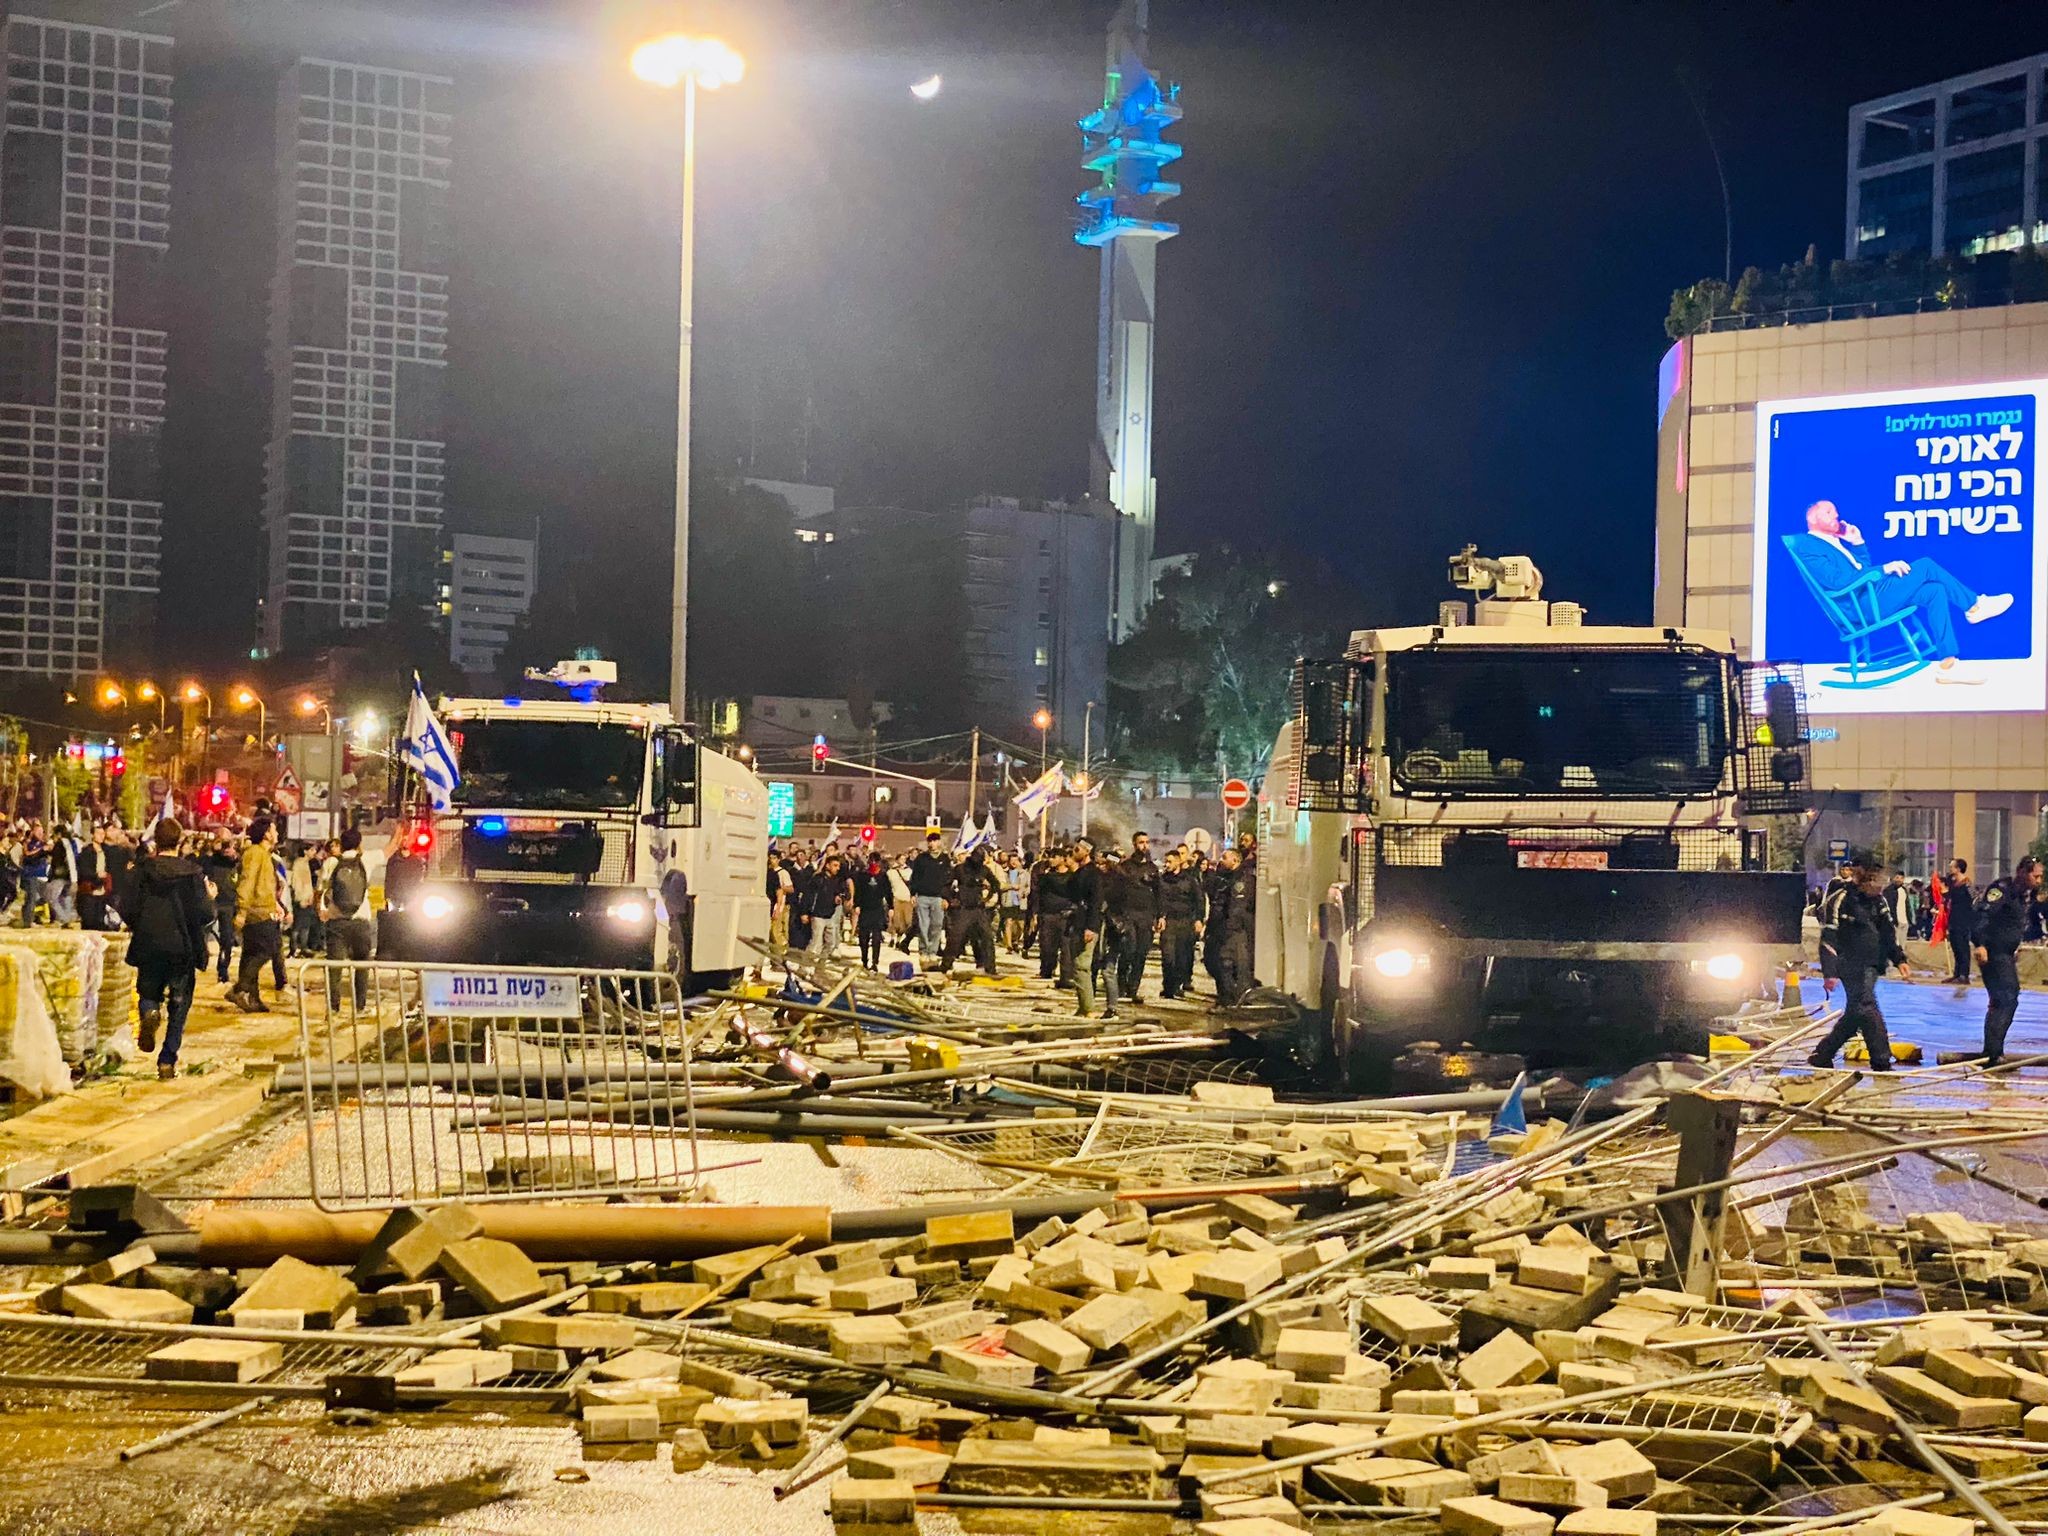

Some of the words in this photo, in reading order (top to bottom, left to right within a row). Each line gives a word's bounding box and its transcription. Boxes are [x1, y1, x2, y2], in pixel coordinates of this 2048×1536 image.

[1886, 413, 1972, 432] הטרלולים!
[1975, 410, 2022, 426] נגמרו
[1916, 424, 2023, 464] לאומי
[1895, 472, 1952, 502] נוח
[1959, 468, 2022, 498] הכי
[1884, 505, 2022, 539] בשירות
[453, 976, 498, 995] במות
[506, 978, 546, 999] קשת
